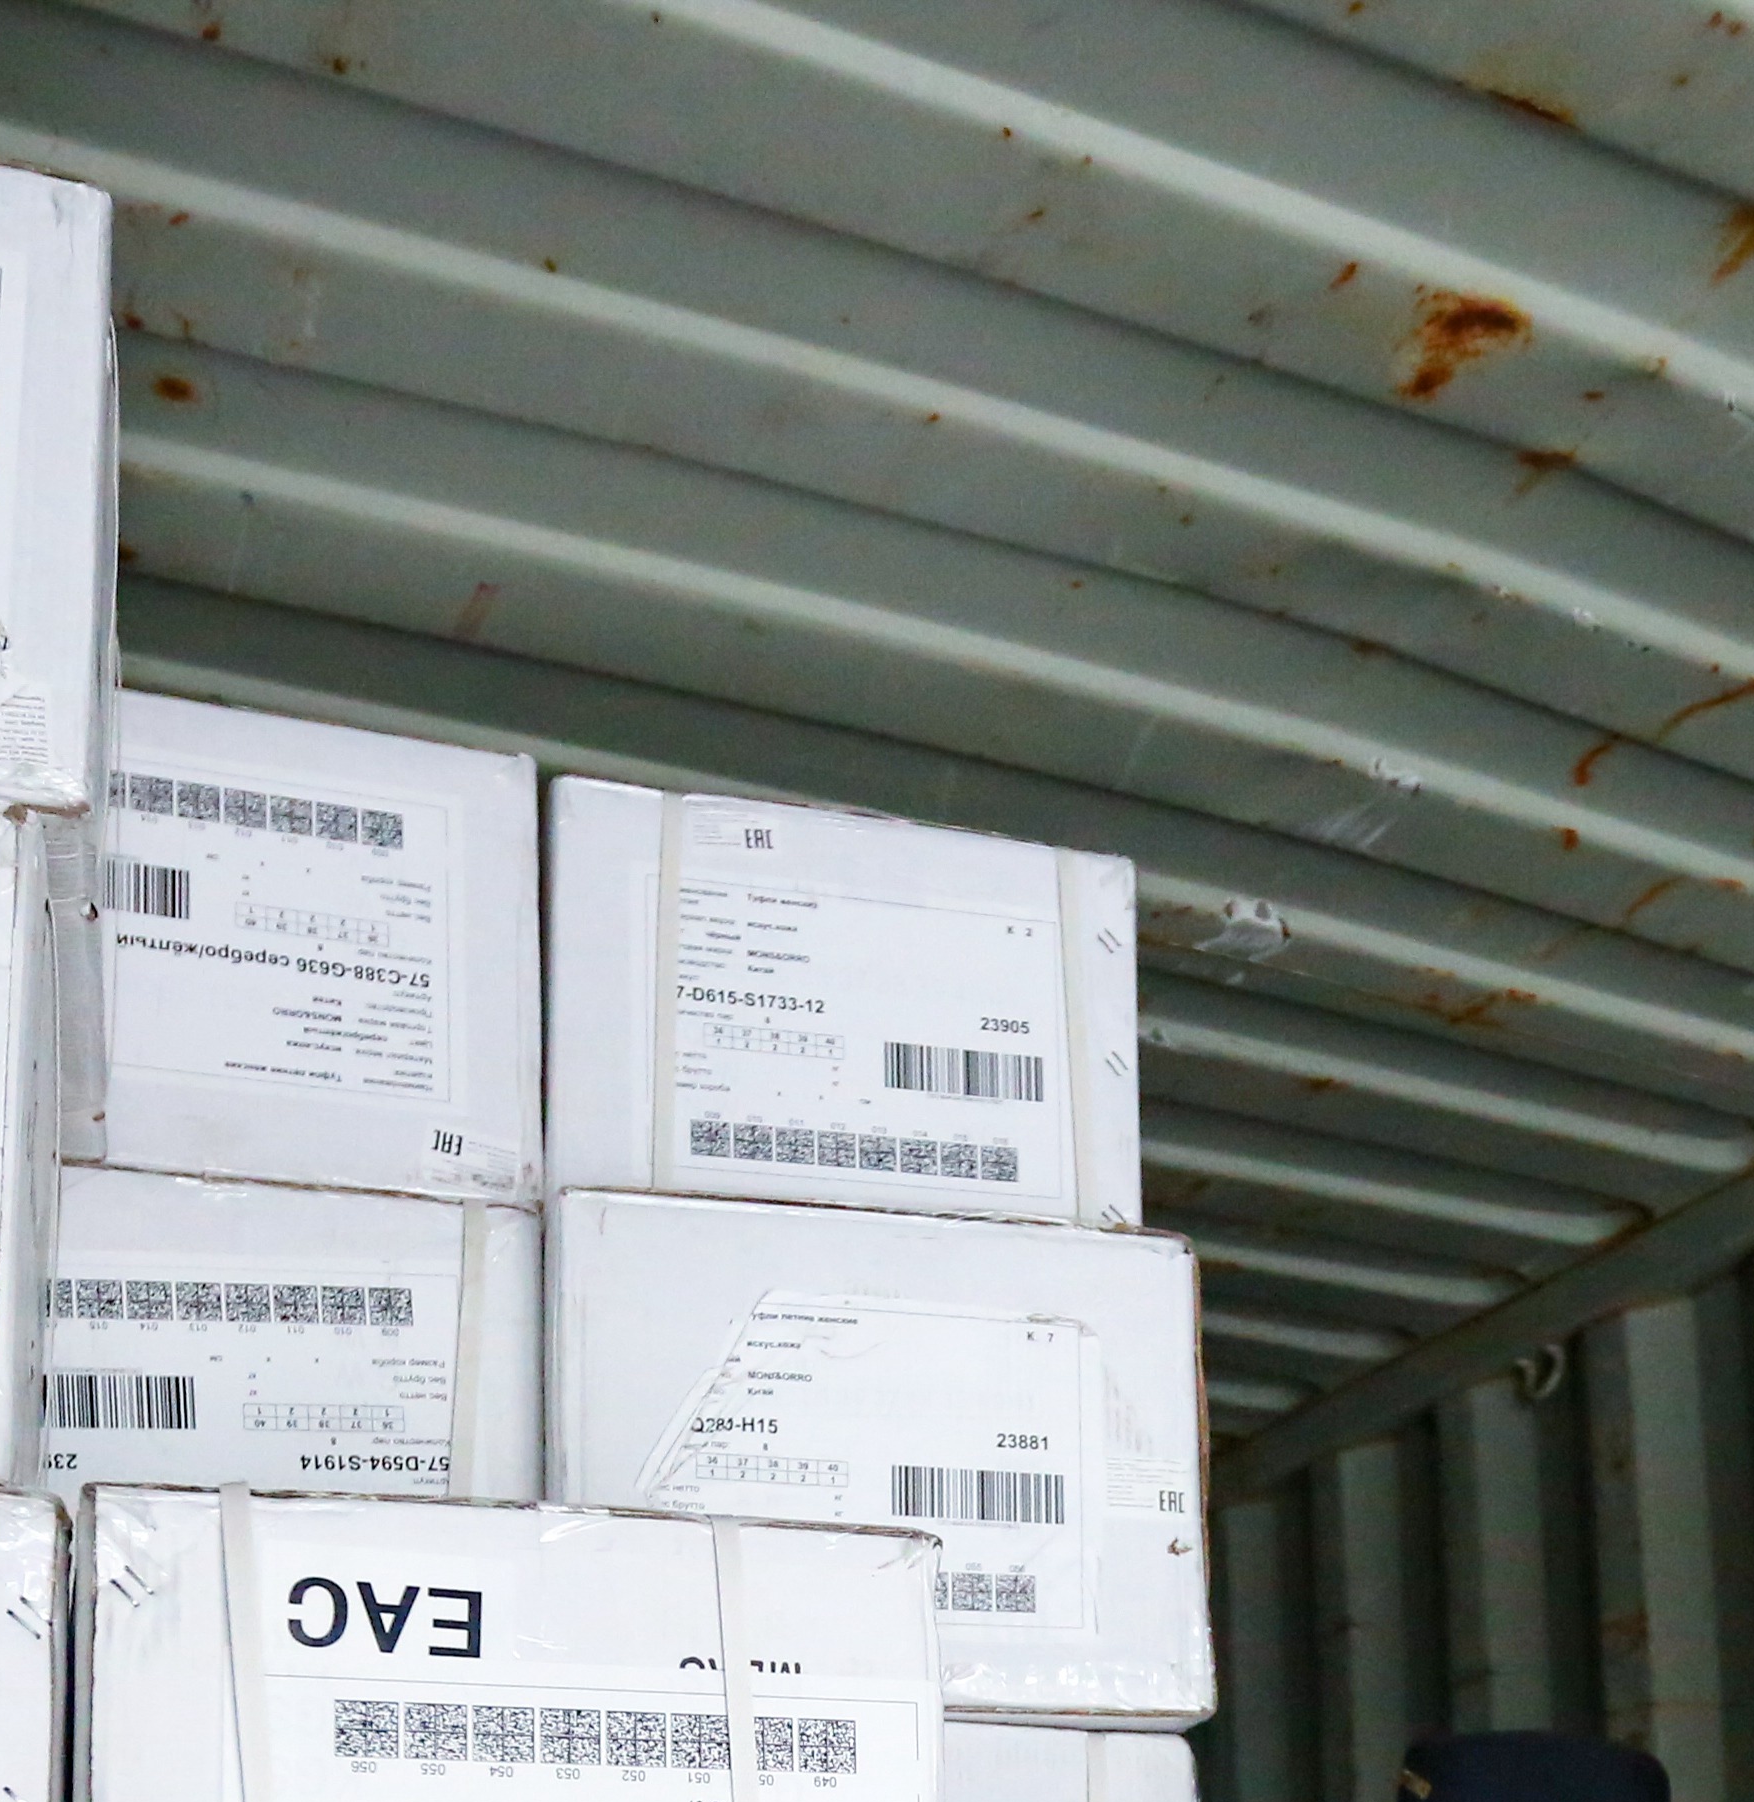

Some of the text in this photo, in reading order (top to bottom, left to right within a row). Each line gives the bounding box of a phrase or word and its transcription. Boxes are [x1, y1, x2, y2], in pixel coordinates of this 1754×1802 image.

[295, 953, 432, 989] 57-C388-G636
[675, 984, 1031, 1035] 7-D615-S1733-12 23905
[996, 1432, 1049, 1451] 23881
[287, 1576, 483, 1659] EAC
[350, 1760, 378, 1774] 056
